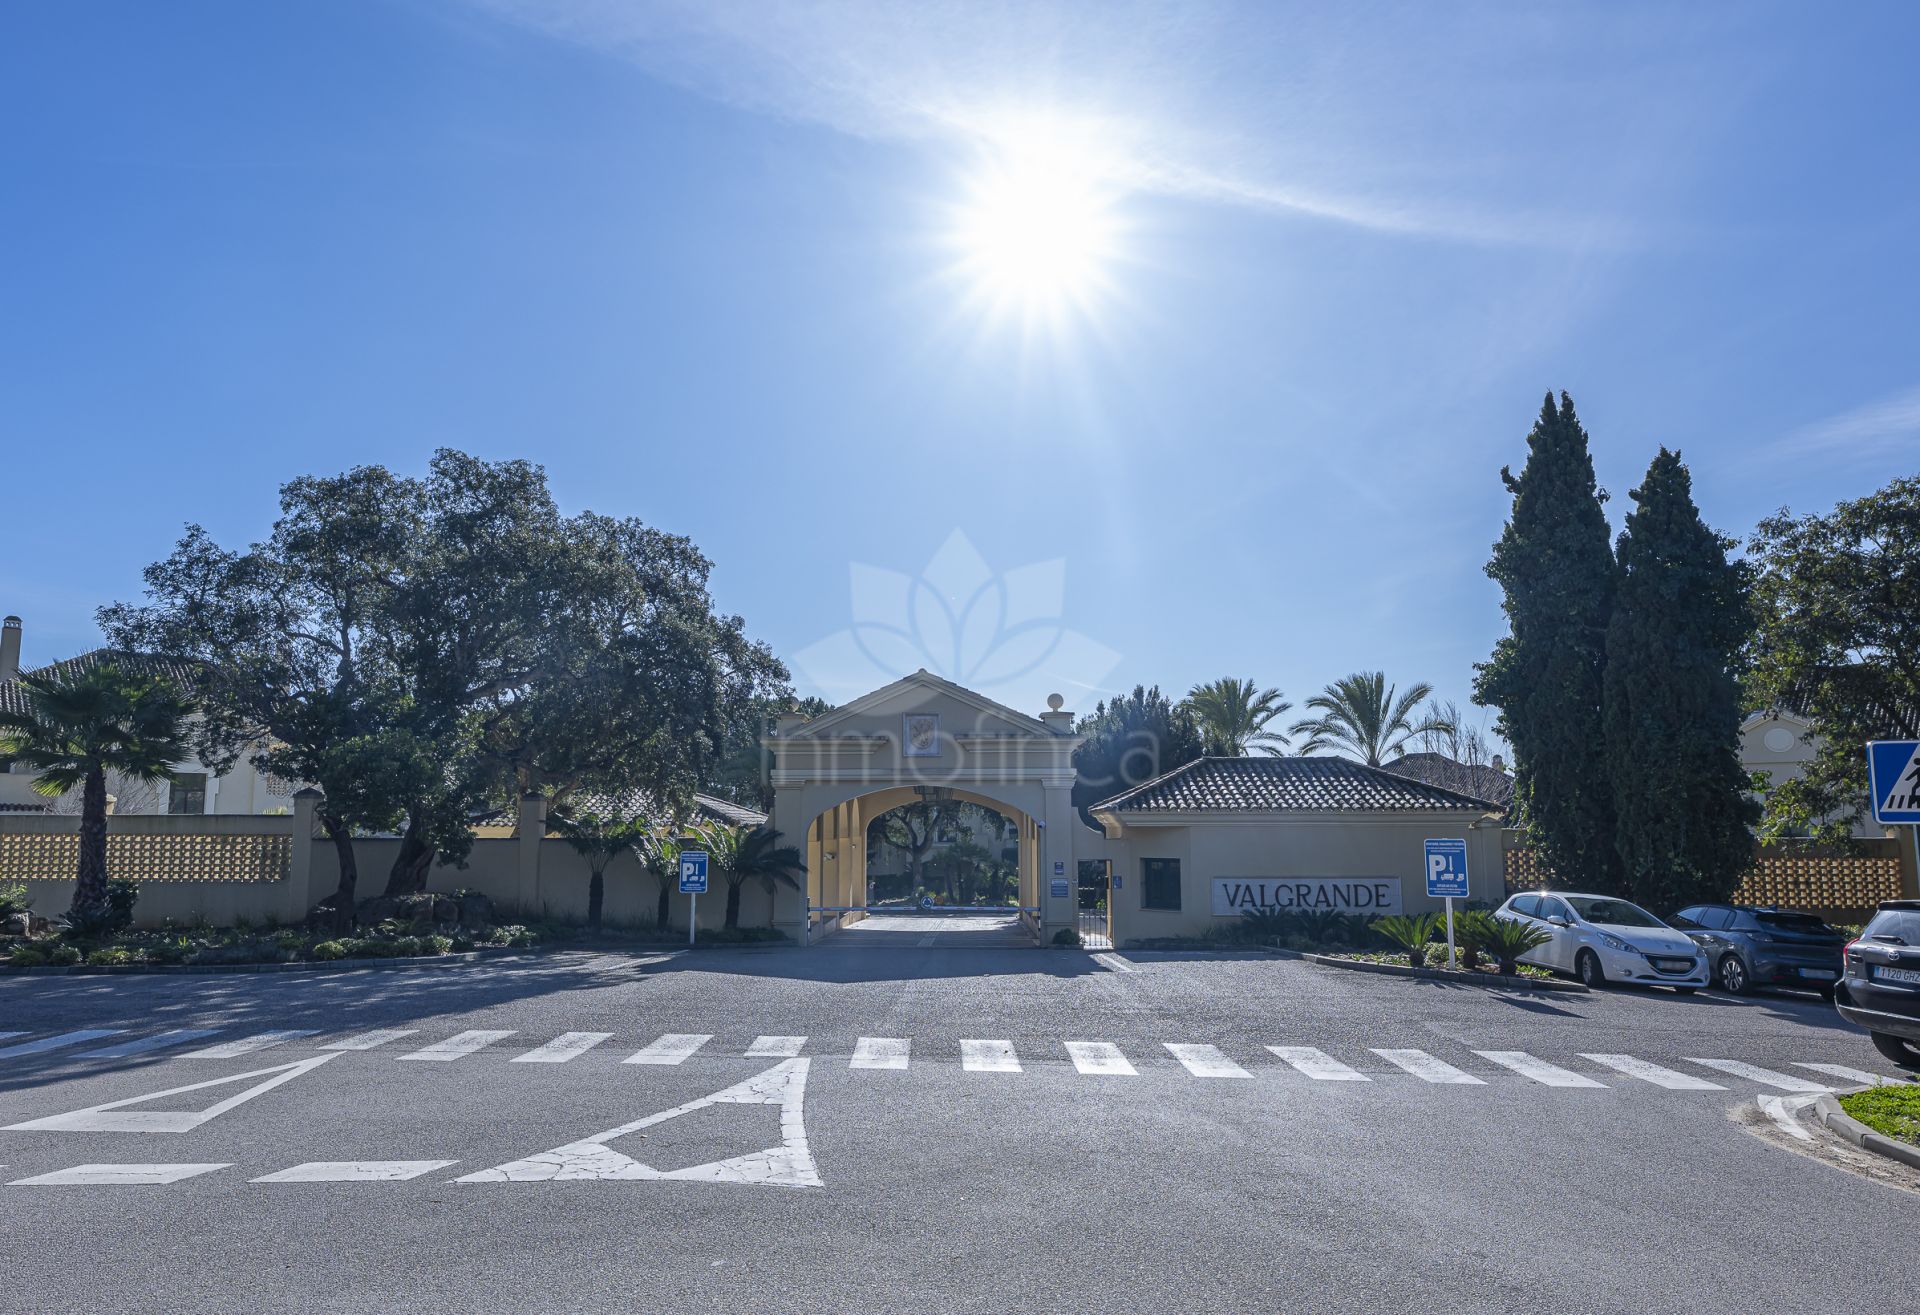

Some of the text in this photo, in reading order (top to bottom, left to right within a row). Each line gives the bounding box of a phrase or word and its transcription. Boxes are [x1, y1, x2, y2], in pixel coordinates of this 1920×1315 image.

[682, 862, 694, 882] P
[1428, 854, 1446, 881] P
[1222, 883, 1392, 908] VALGRANDE
[1881, 968, 1902, 979] 1120
